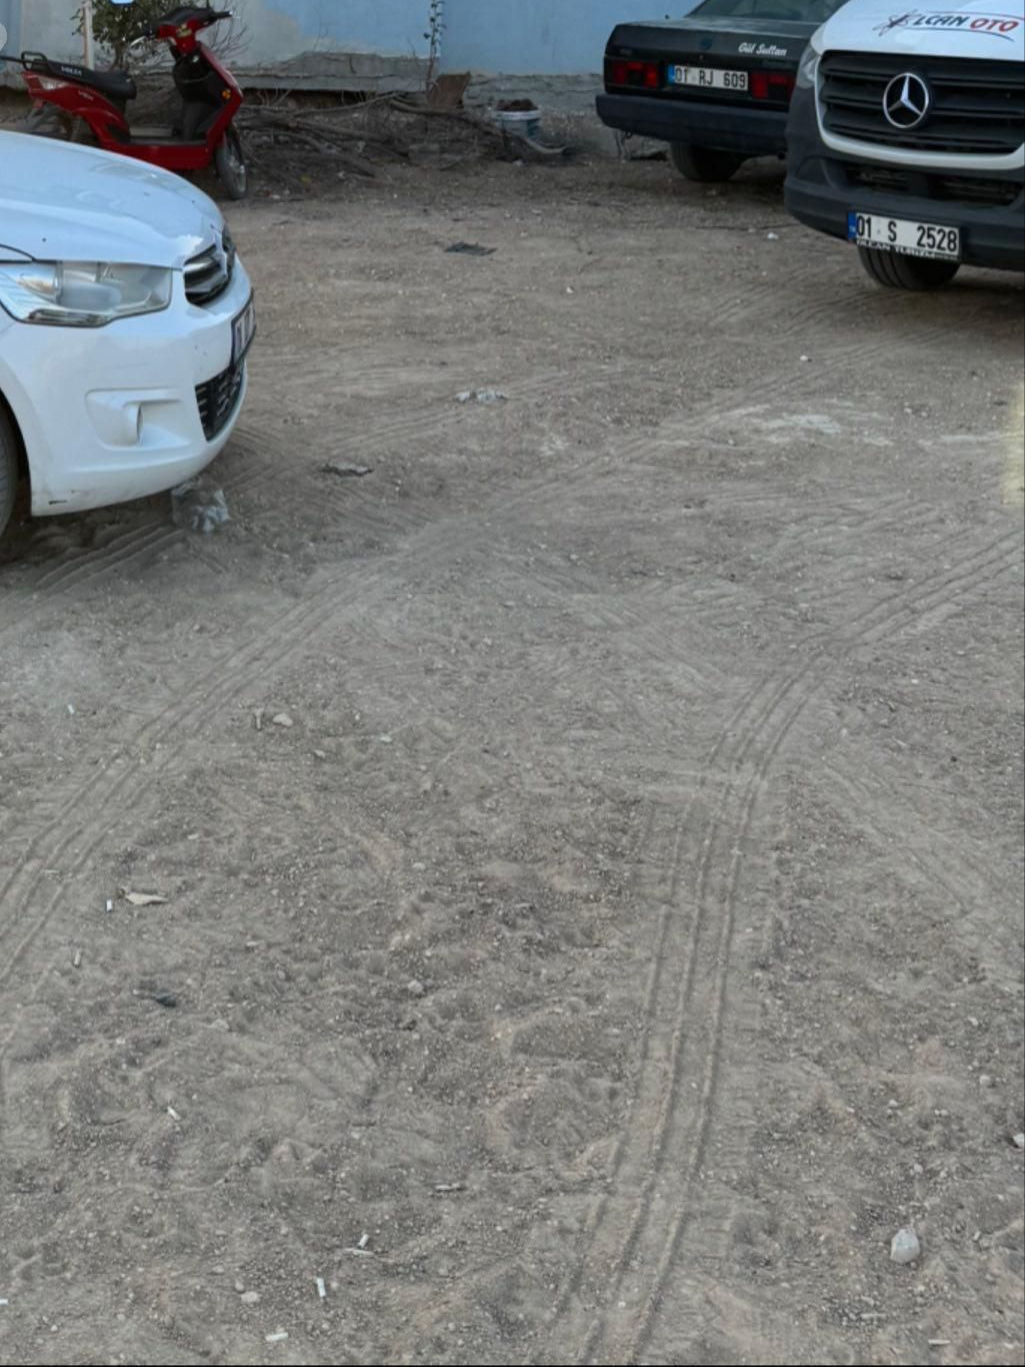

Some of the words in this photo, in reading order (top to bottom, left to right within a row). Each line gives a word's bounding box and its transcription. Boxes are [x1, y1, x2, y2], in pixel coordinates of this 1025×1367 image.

[970, 18, 1019, 33] OTO
[699, 72, 713, 86] RJ
[723, 74, 746, 89] 609
[857, 216, 872, 238] 01
[887, 220, 897, 242] S
[916, 225, 957, 252] 2528
